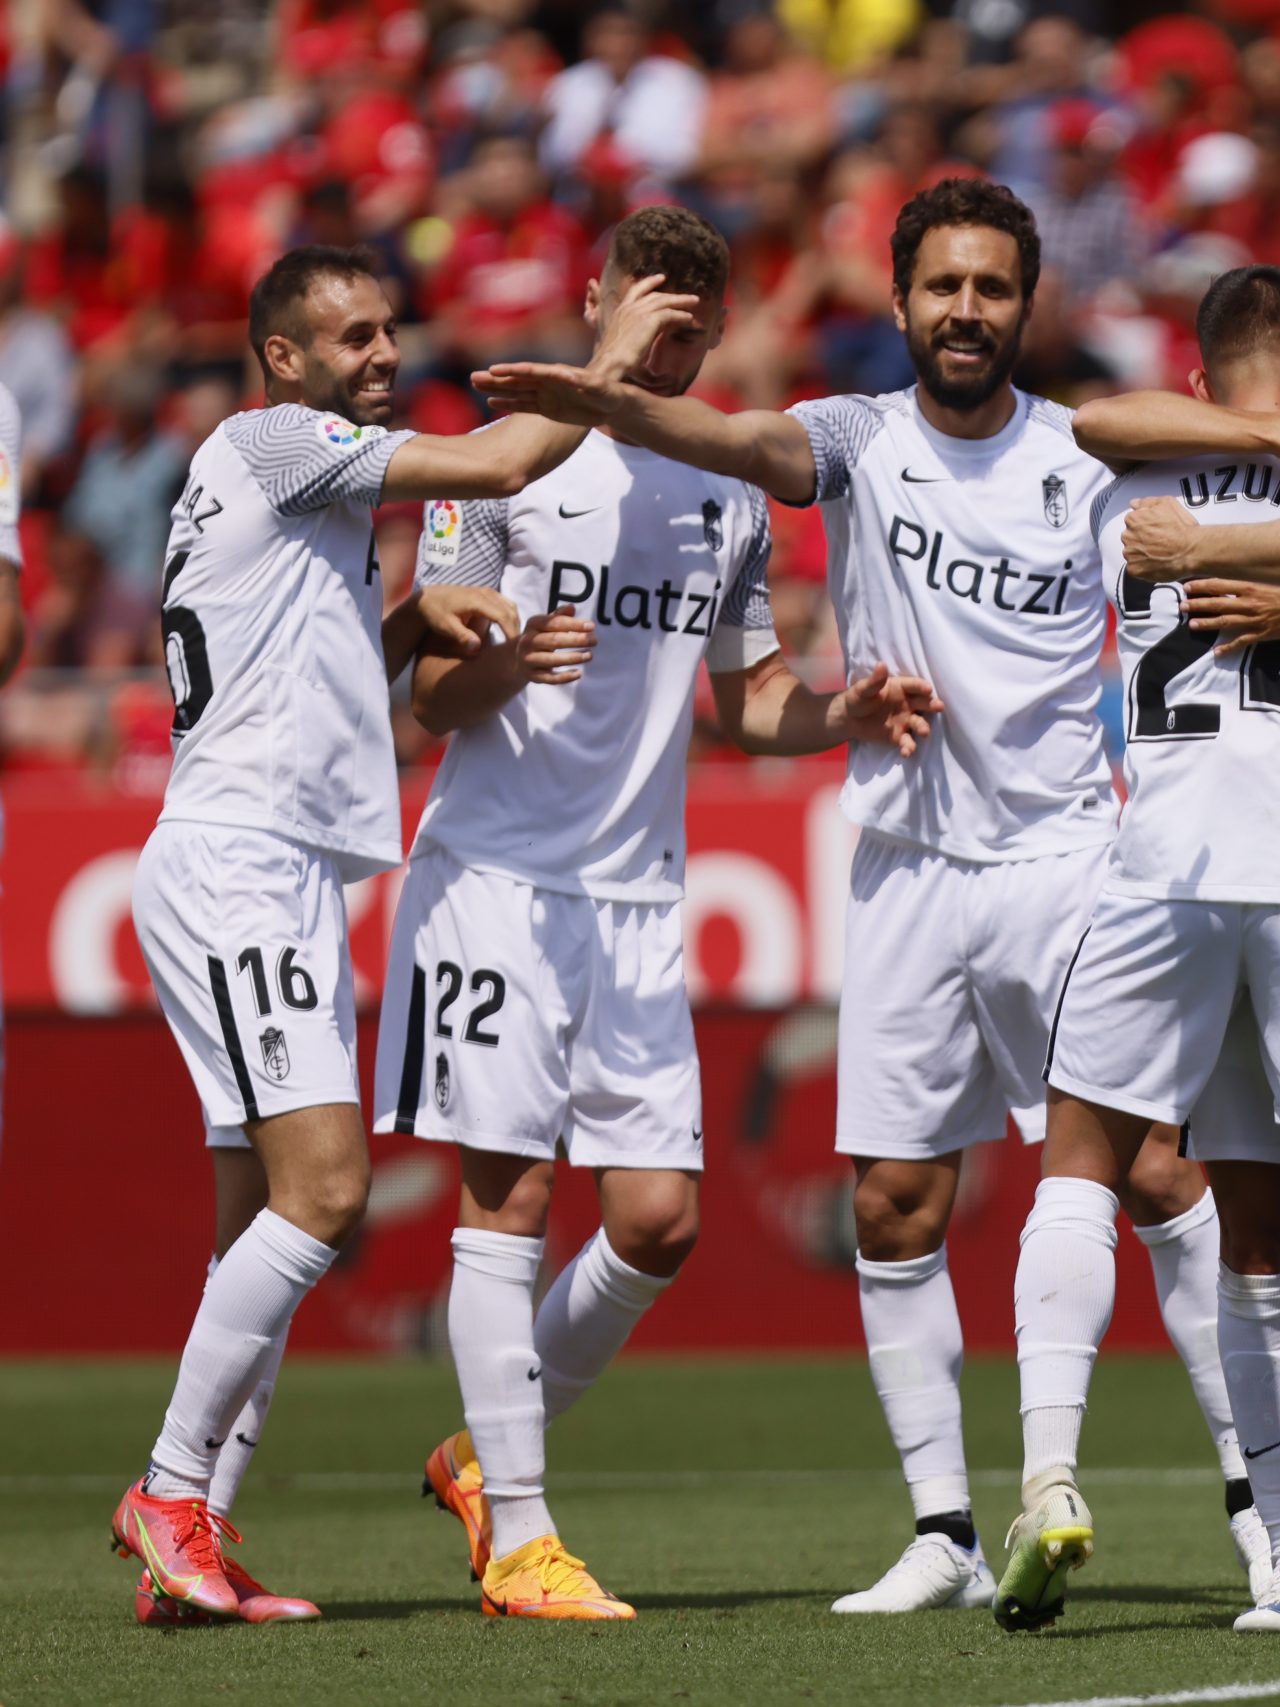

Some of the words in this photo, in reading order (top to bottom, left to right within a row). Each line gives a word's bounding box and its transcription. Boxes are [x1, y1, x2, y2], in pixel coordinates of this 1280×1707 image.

[547, 560, 722, 638] Platzi
[889, 514, 1073, 616] Platzi
[235, 945, 319, 1019] 16
[433, 960, 506, 1048] 22
